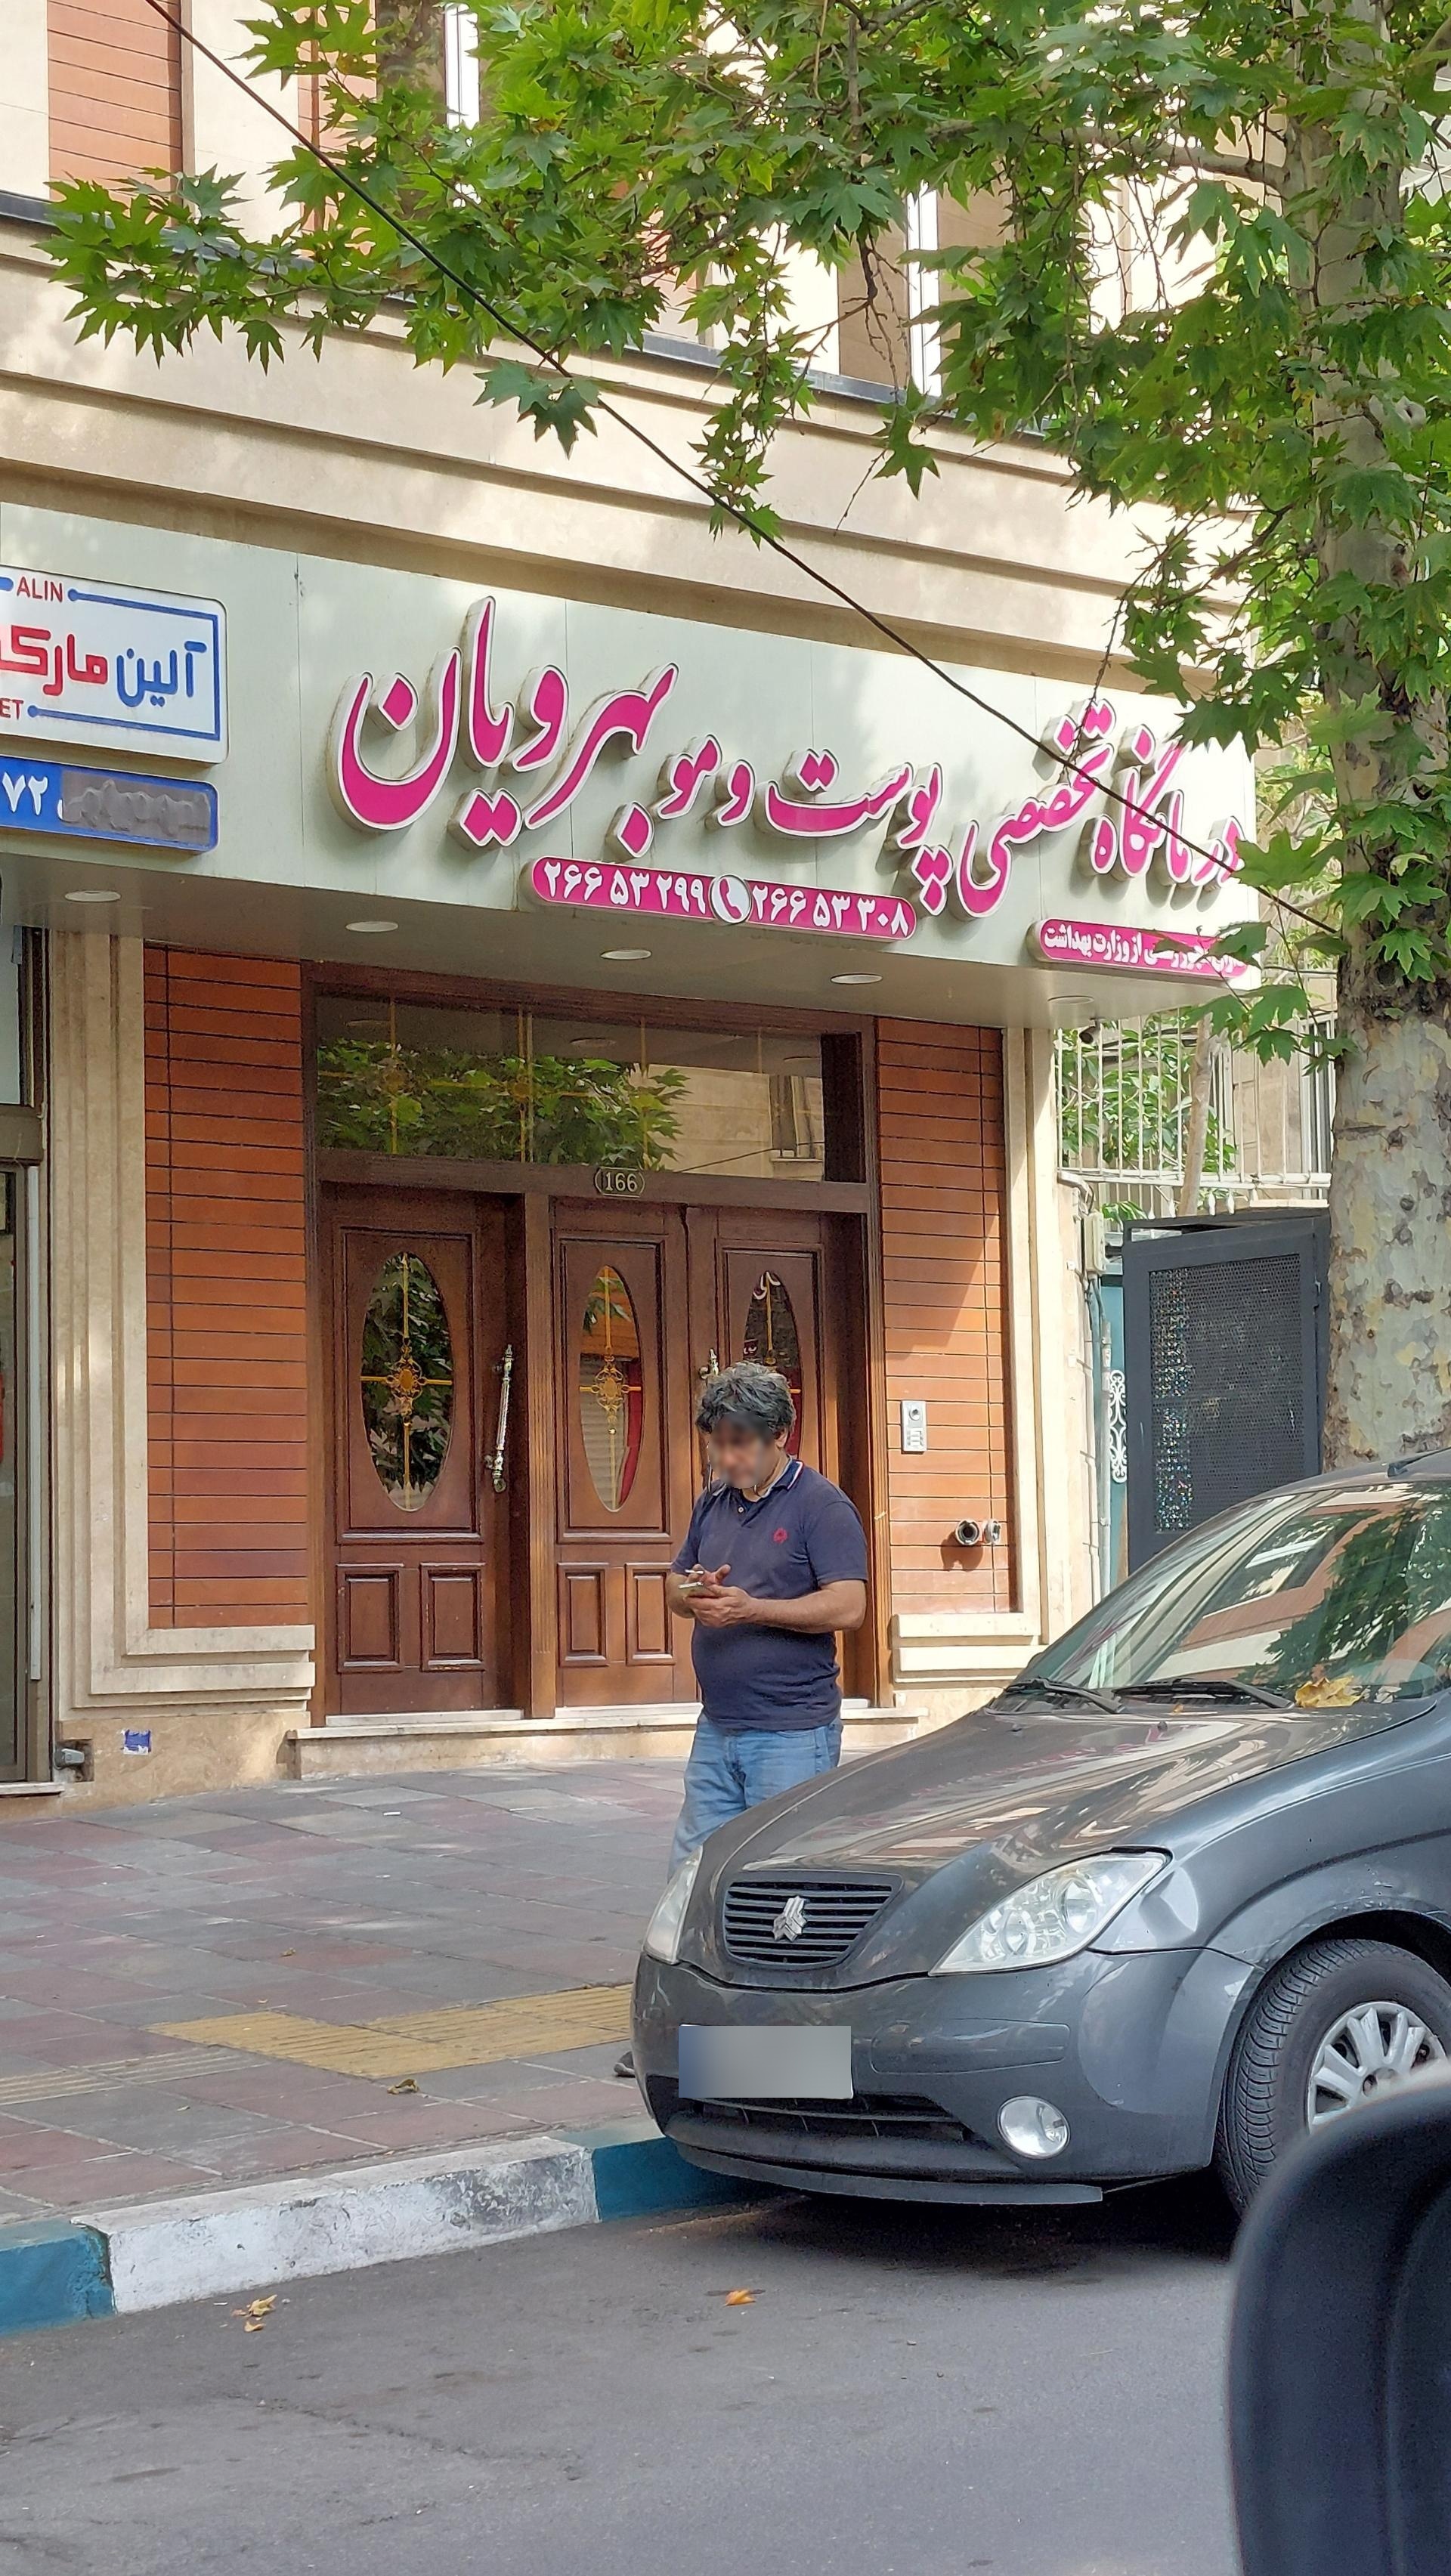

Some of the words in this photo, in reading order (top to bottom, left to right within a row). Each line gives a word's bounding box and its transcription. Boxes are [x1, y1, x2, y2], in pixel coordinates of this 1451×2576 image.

[16, 577, 63, 603] ALIN
[0, 624, 109, 696] مارک
[116, 641, 207, 708] آلین
[657, 734, 722, 820] مو
[718, 759, 756, 827] و
[763, 748, 954, 917] پوست
[955, 698, 1116, 917] تخصصی
[543, 861, 603, 901] ۲۶۶
[610, 869, 650, 907] ۵۳
[656, 874, 707, 914] ۲۹۹
[752, 884, 807, 923] ۲۶۶
[812, 892, 851, 929] ۵۳
[856, 897, 909, 937] ۳۰۸
[1044, 923, 1093, 958] بهداشت
[1092, 929, 1130, 963] وزارت
[1129, 931, 1143, 964] از
[605, 1172, 638, 1192] 166
